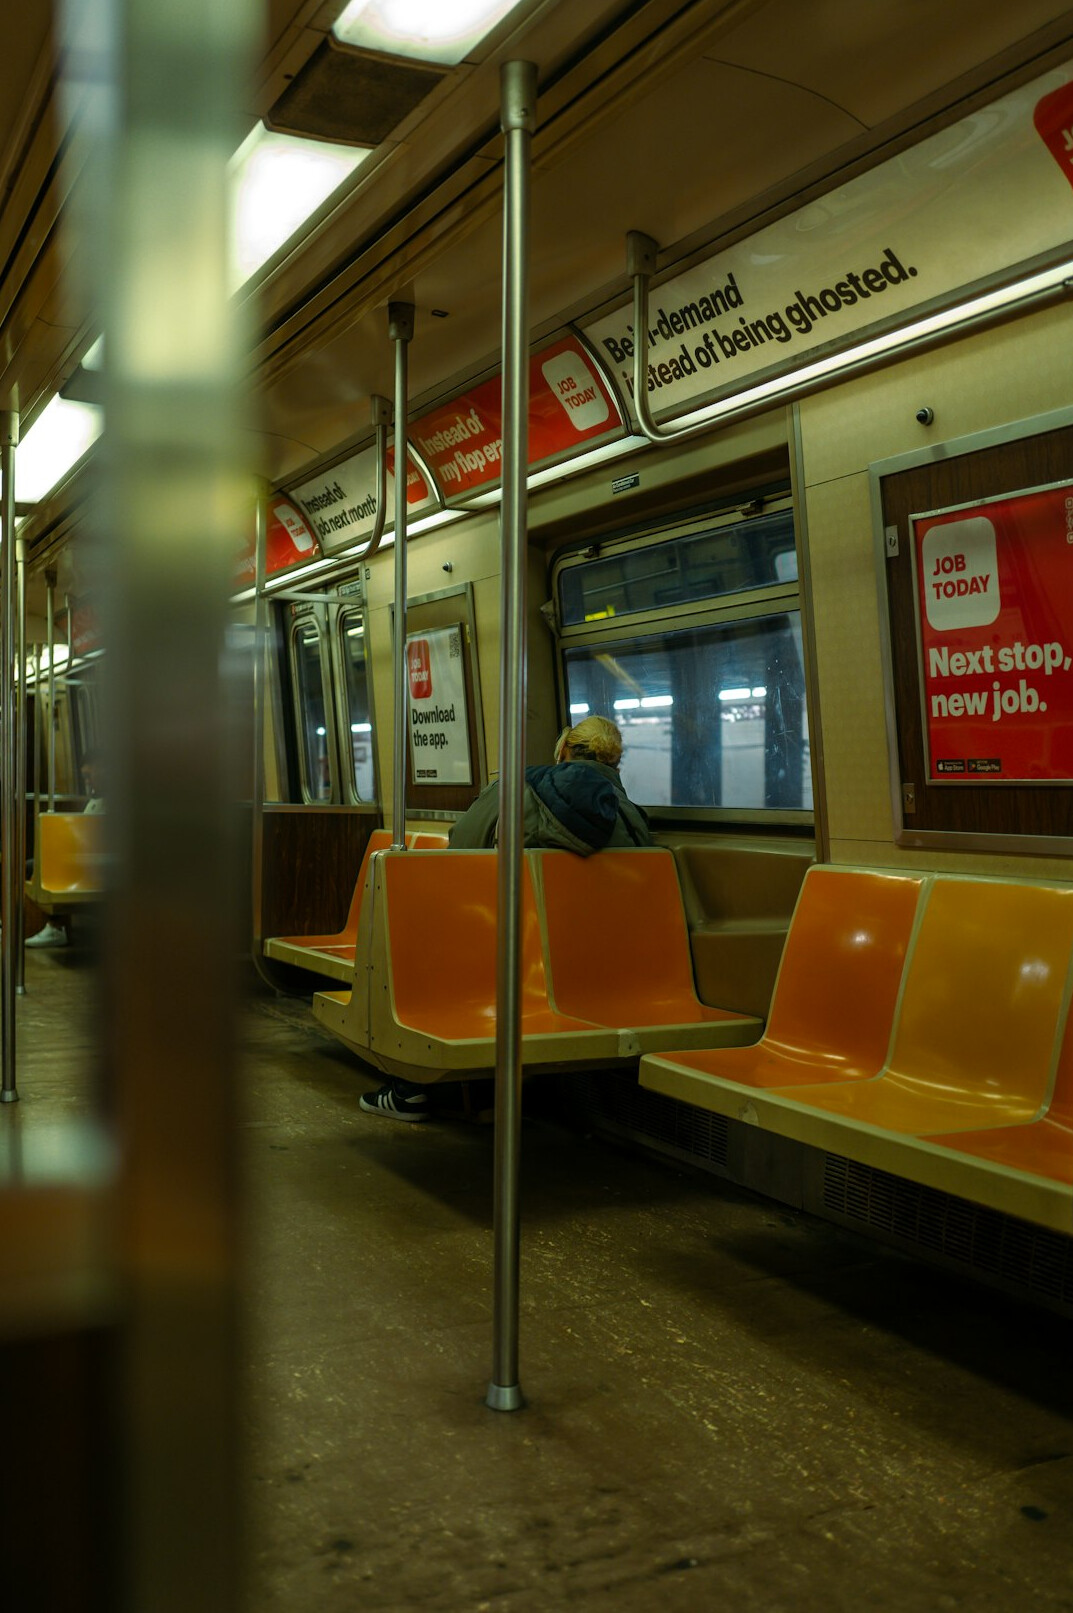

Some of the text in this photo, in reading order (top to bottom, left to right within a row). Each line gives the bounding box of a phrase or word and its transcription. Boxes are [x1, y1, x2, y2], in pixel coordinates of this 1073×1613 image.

[602, 272, 744, 364] Be -demand
[622, 248, 918, 399] istead of being ghosted.
[556, 376, 578, 396] JOB
[565, 386, 598, 410] TODAY
[418, 408, 485, 457] Instead of
[439, 460, 462, 482] my
[454, 449, 486, 474] flop
[302, 481, 348, 515] Instead of
[314, 516, 332, 541] job
[328, 509, 351, 531] next
[933, 554, 967, 576] JOB
[932, 574, 991, 600] TODAY
[928, 641, 1073, 678] Next stop,
[412, 703, 456, 725] Download
[931, 679, 1048, 722] new job.
[413, 729, 449, 750] the app.
